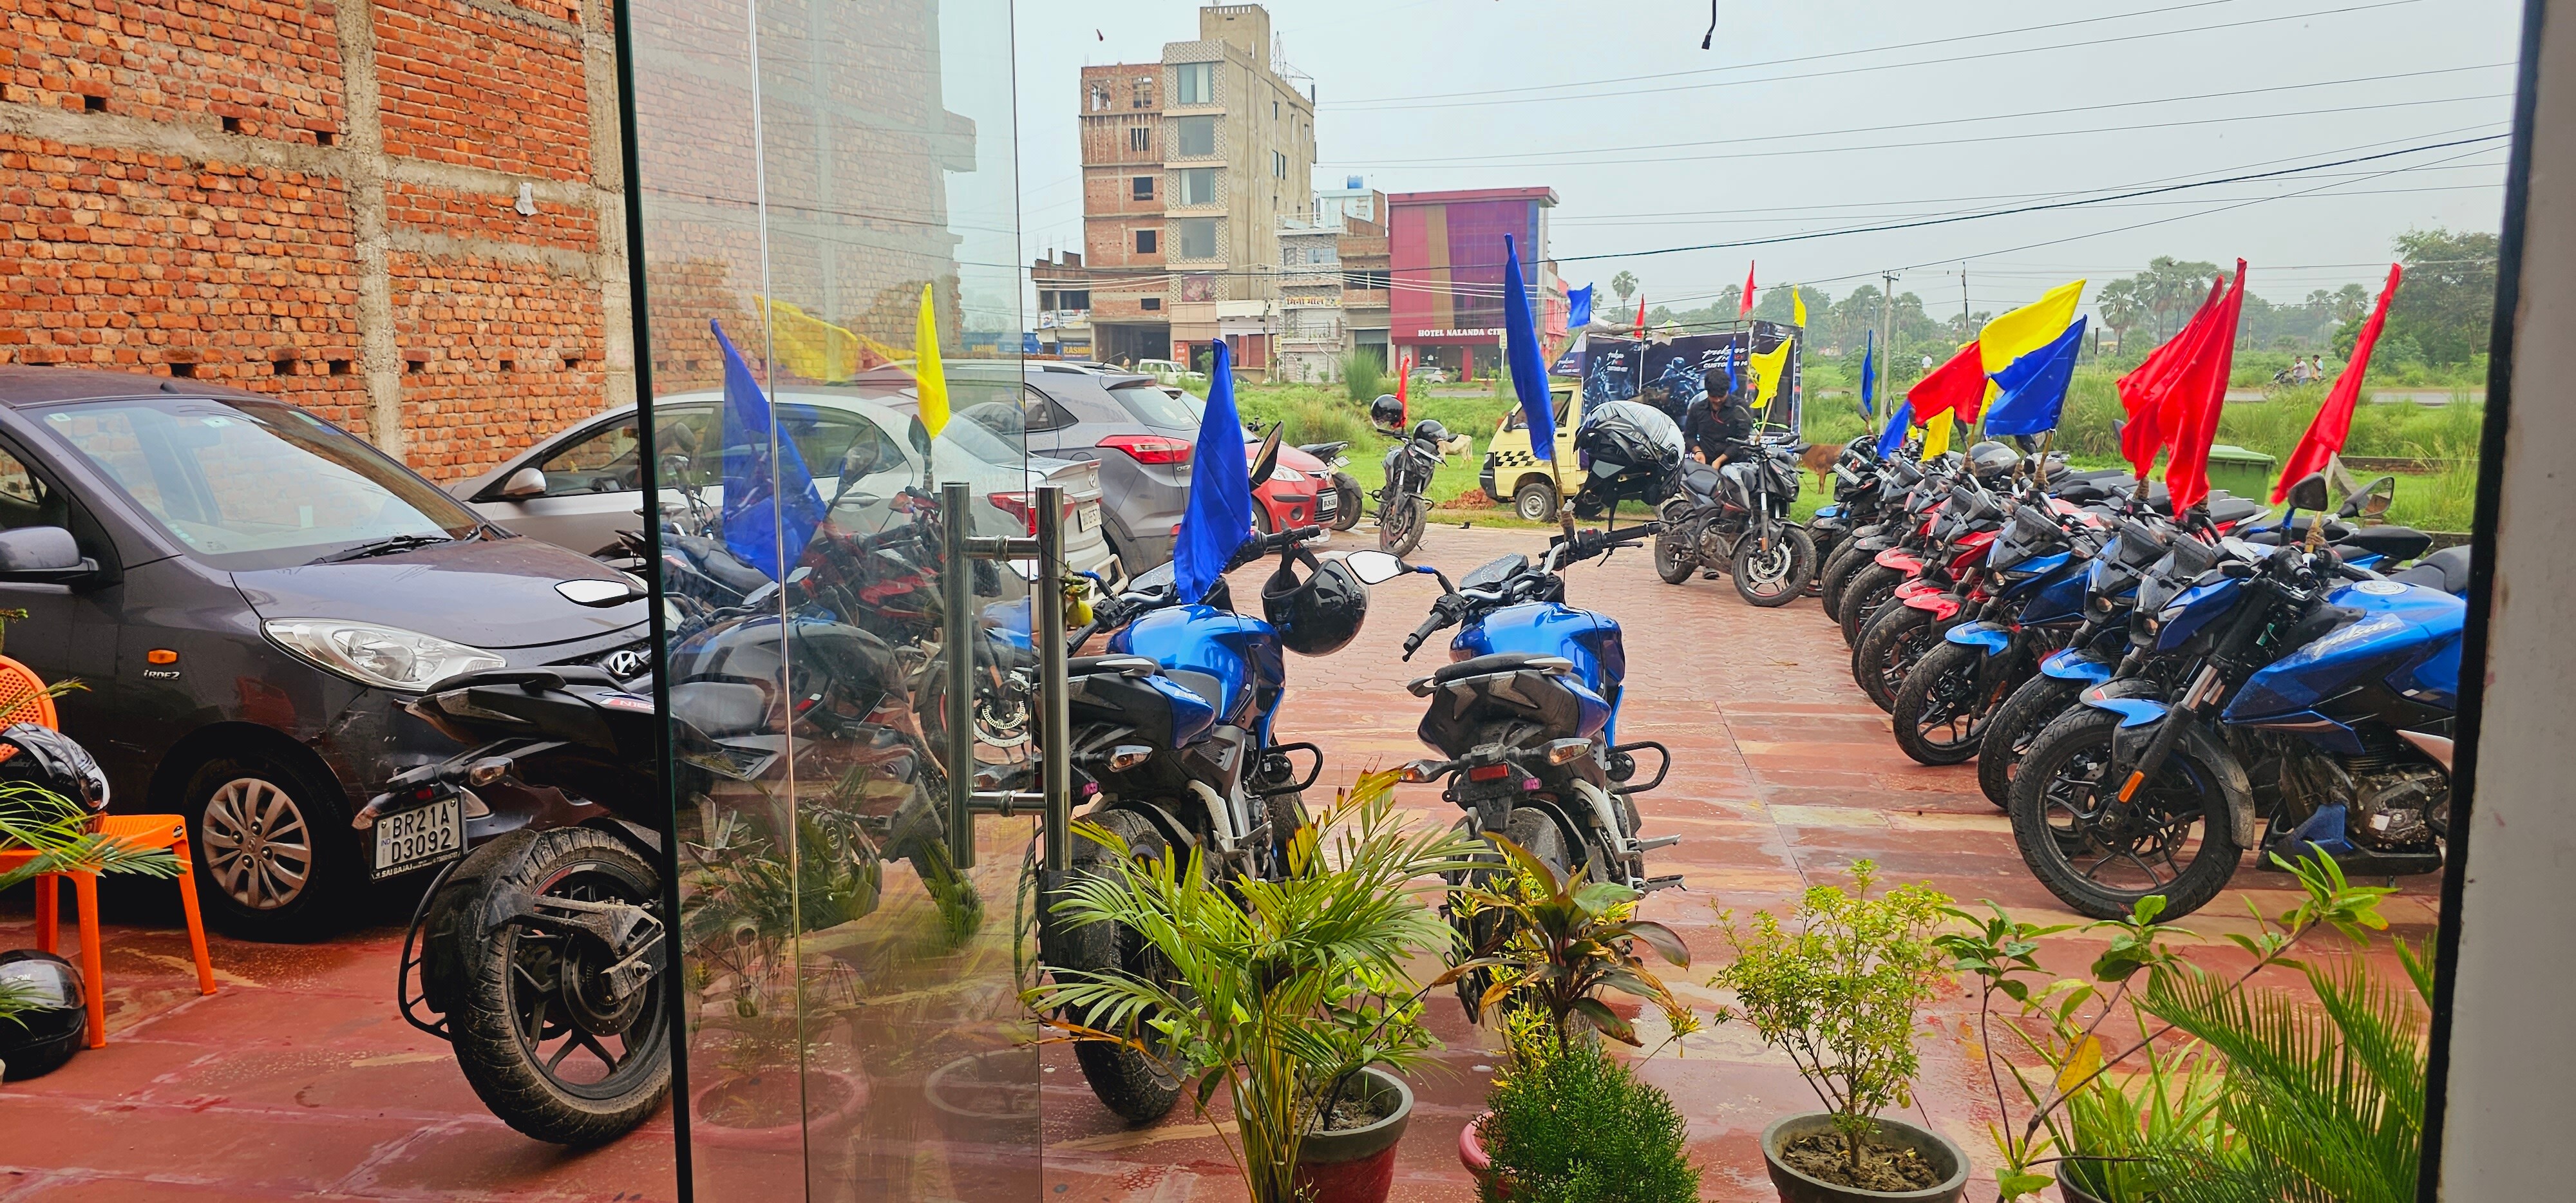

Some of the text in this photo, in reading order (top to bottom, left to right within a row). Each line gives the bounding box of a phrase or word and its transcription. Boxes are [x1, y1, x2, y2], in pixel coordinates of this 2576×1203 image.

[392, 803, 450, 838] BR21A
[391, 827, 451, 864] D3092
[393, 863, 413, 875] BAJAJ
